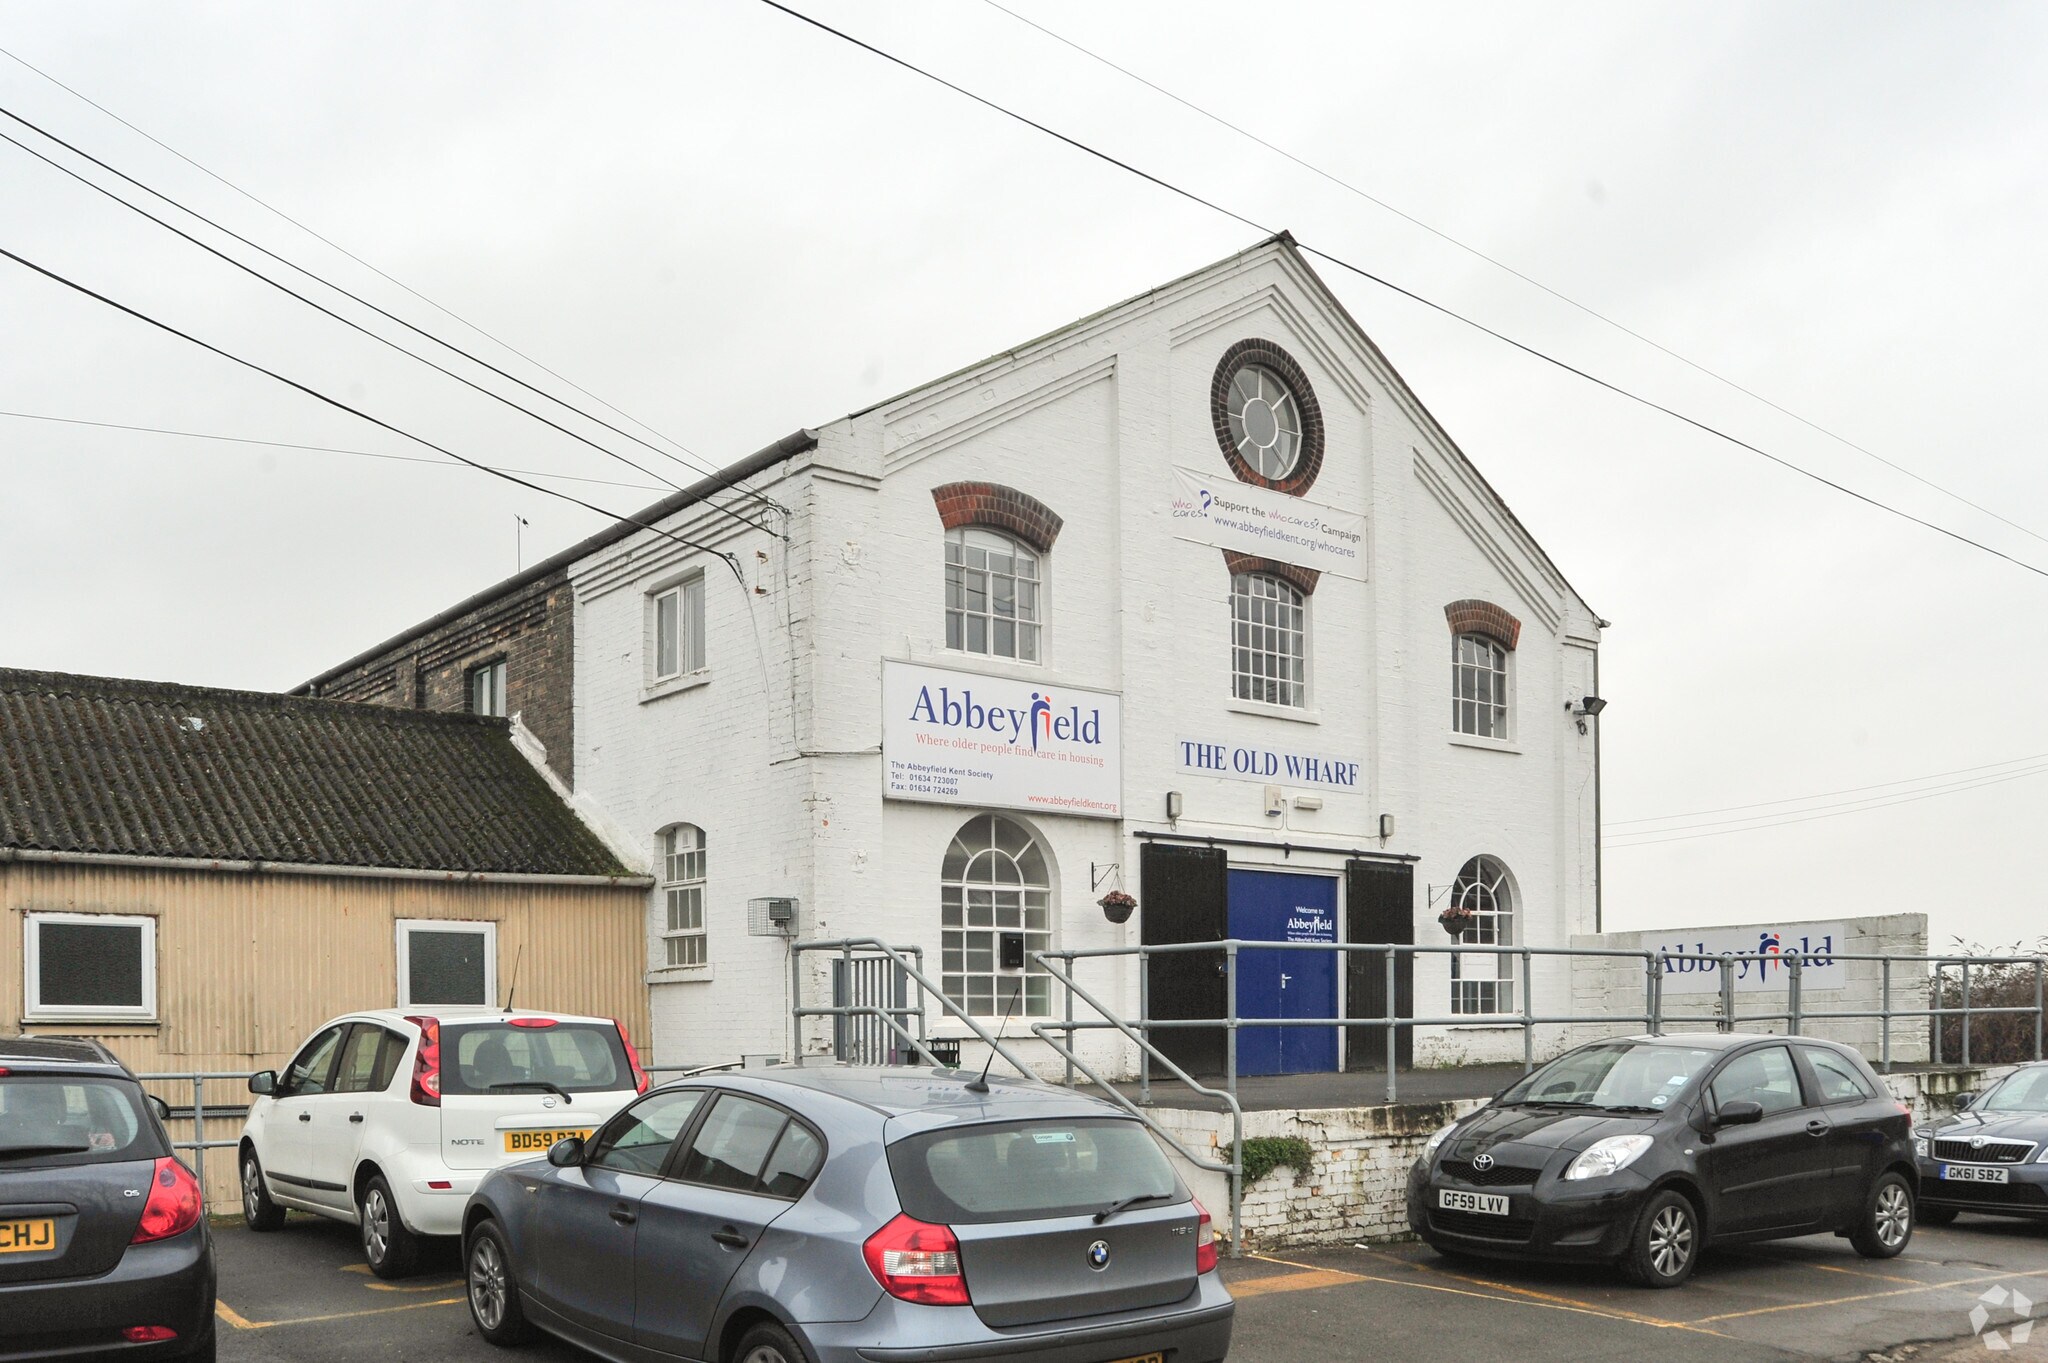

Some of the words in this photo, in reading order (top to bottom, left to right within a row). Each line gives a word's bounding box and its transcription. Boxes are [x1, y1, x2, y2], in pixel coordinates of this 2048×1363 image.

[1172, 498, 1193, 509] who
[1213, 496, 1249, 513] Support
[1251, 506, 1266, 518] the
[1321, 524, 1361, 543] Campaign
[1213, 516, 1355, 558] www.abbeyfieldkent.org/whocares
[909, 685, 1102, 753] Abbeyfield
[916, 733, 949, 747] Where
[952, 736, 977, 750] older
[980, 741, 1012, 755] people
[1015, 745, 1033, 757] find
[1036, 750, 1056, 760] care
[1058, 750, 1067, 761] in
[1069, 752, 1104, 768] housing
[891, 761, 905, 770] The
[907, 763, 947, 774] Abbeyfield
[949, 767, 966, 776] Kent
[967, 769, 994, 780] Society
[1181, 741, 1227, 771] THE
[1233, 748, 1278, 776] OLD
[1285, 755, 1359, 786] WHARF
[891, 772, 904, 780] Tel:
[909, 774, 931, 782] 01634
[933, 776, 958, 785] 723007
[891, 782, 907, 790] Fax:
[909, 784, 931, 792] 01634
[933, 786, 958, 796] 724269
[1027, 795, 1117, 813] www.abbeyfieldkent.org
[1295, 906, 1318, 914] Welcome
[1287, 916, 1332, 935] Abbeyfield
[511, 1132, 552, 1149] BD59
[1949, 1167, 1975, 1179] GK61
[1978, 1169, 2003, 1181] SBZ
[1444, 1192, 1475, 1209] GF59
[1478, 1196, 1503, 1212] LVV
